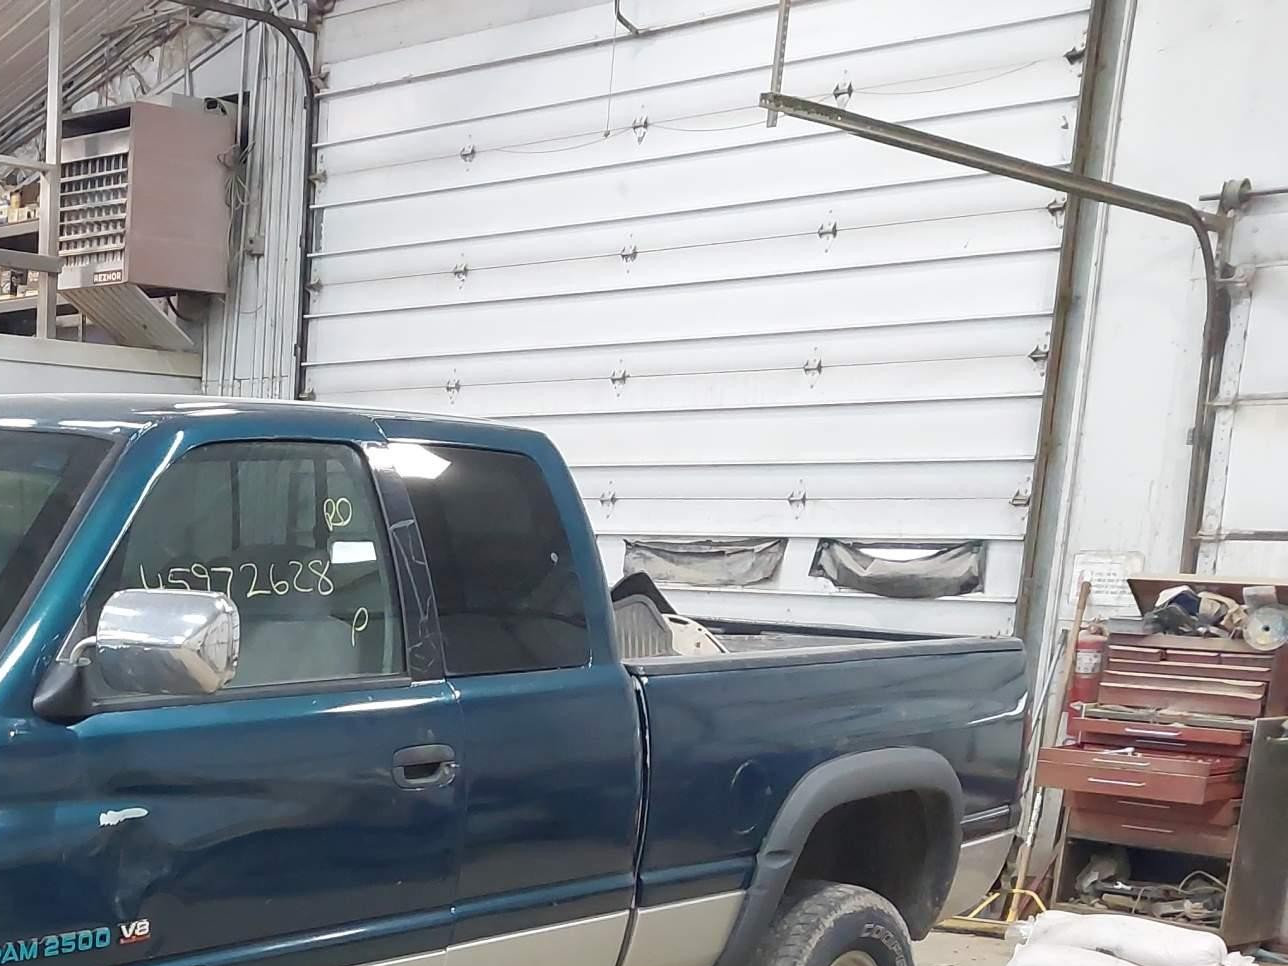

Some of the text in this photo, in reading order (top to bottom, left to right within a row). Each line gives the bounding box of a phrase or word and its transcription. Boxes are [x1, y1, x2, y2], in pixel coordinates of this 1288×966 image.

[94, 271, 122, 282] REZNOR
[140, 560, 334, 598] 45972628
[43, 926, 111, 957] 2500
[118, 919, 150, 939] V8
